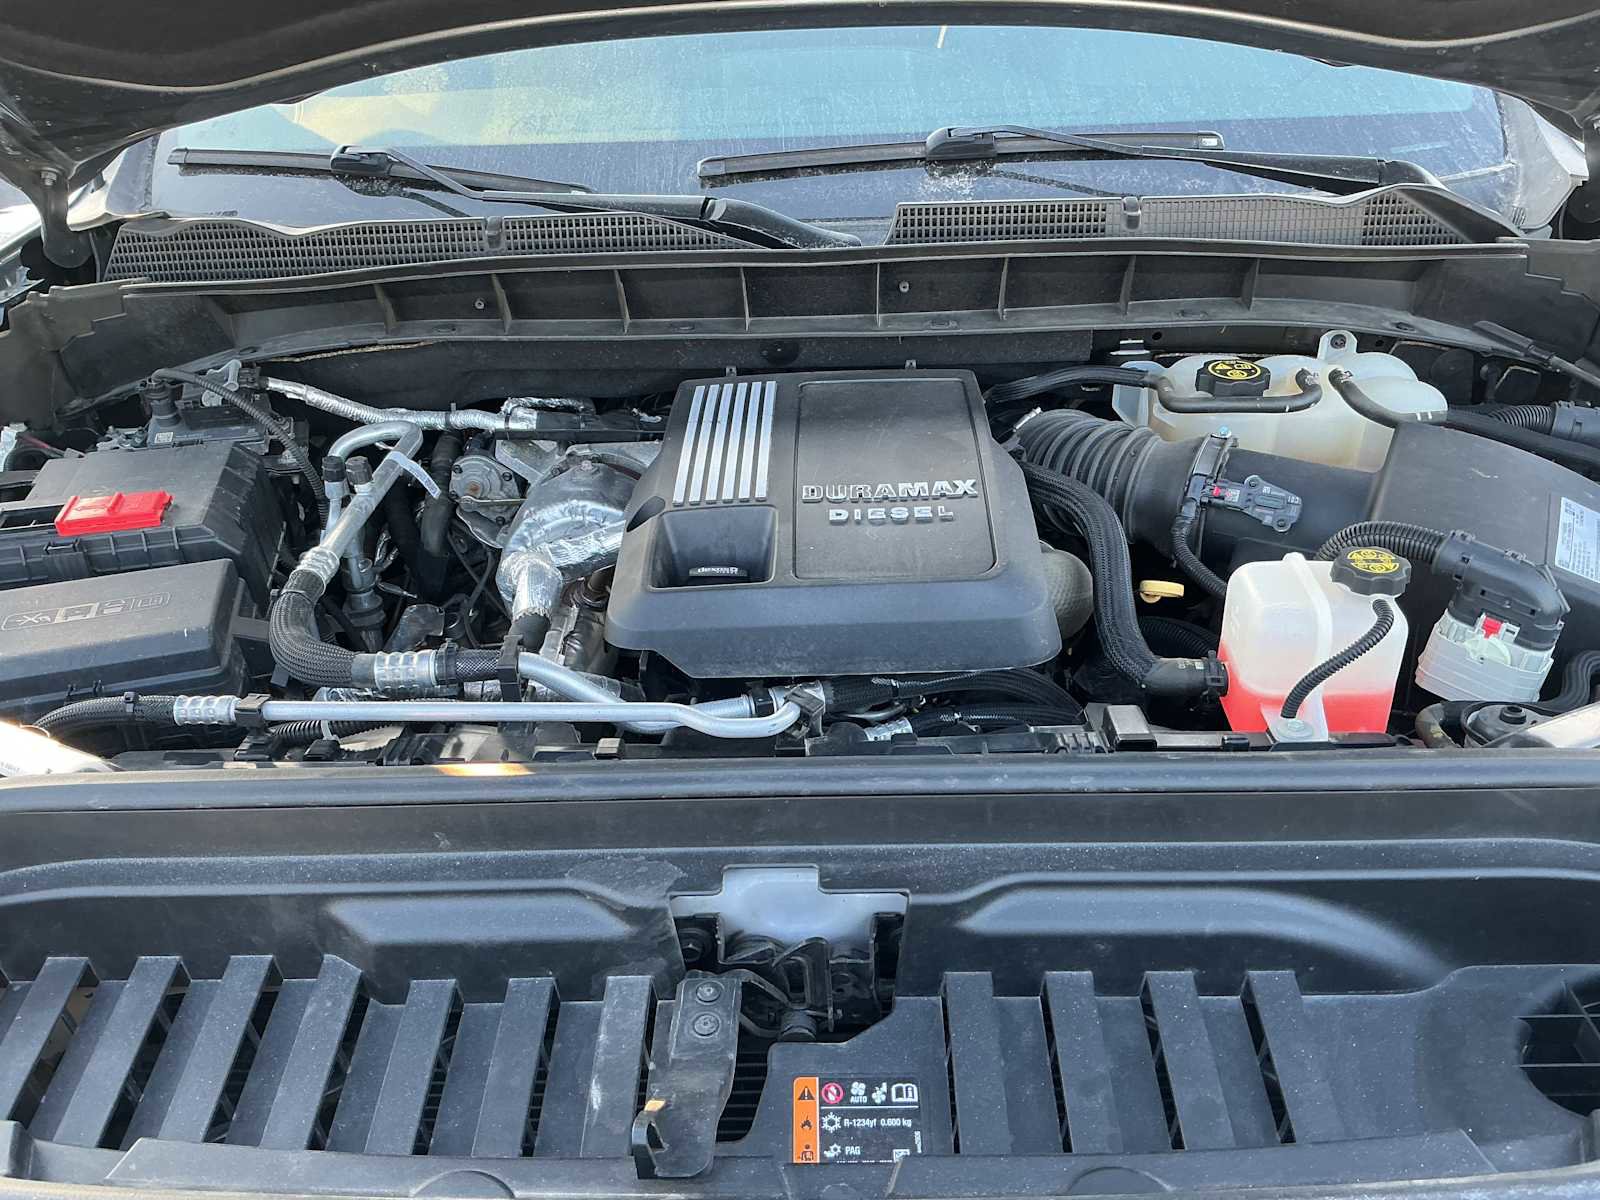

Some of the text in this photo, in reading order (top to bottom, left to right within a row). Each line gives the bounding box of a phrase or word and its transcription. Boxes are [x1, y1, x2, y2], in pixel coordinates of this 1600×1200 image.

[802, 479, 978, 502] DURAMAX
[828, 505, 954, 524] DIESEL
[850, 1095, 867, 1104] AUTO
[843, 1118, 877, 1129] R-1234yf
[902, 1118, 912, 1128] kg
[845, 1145, 861, 1155] PAG
